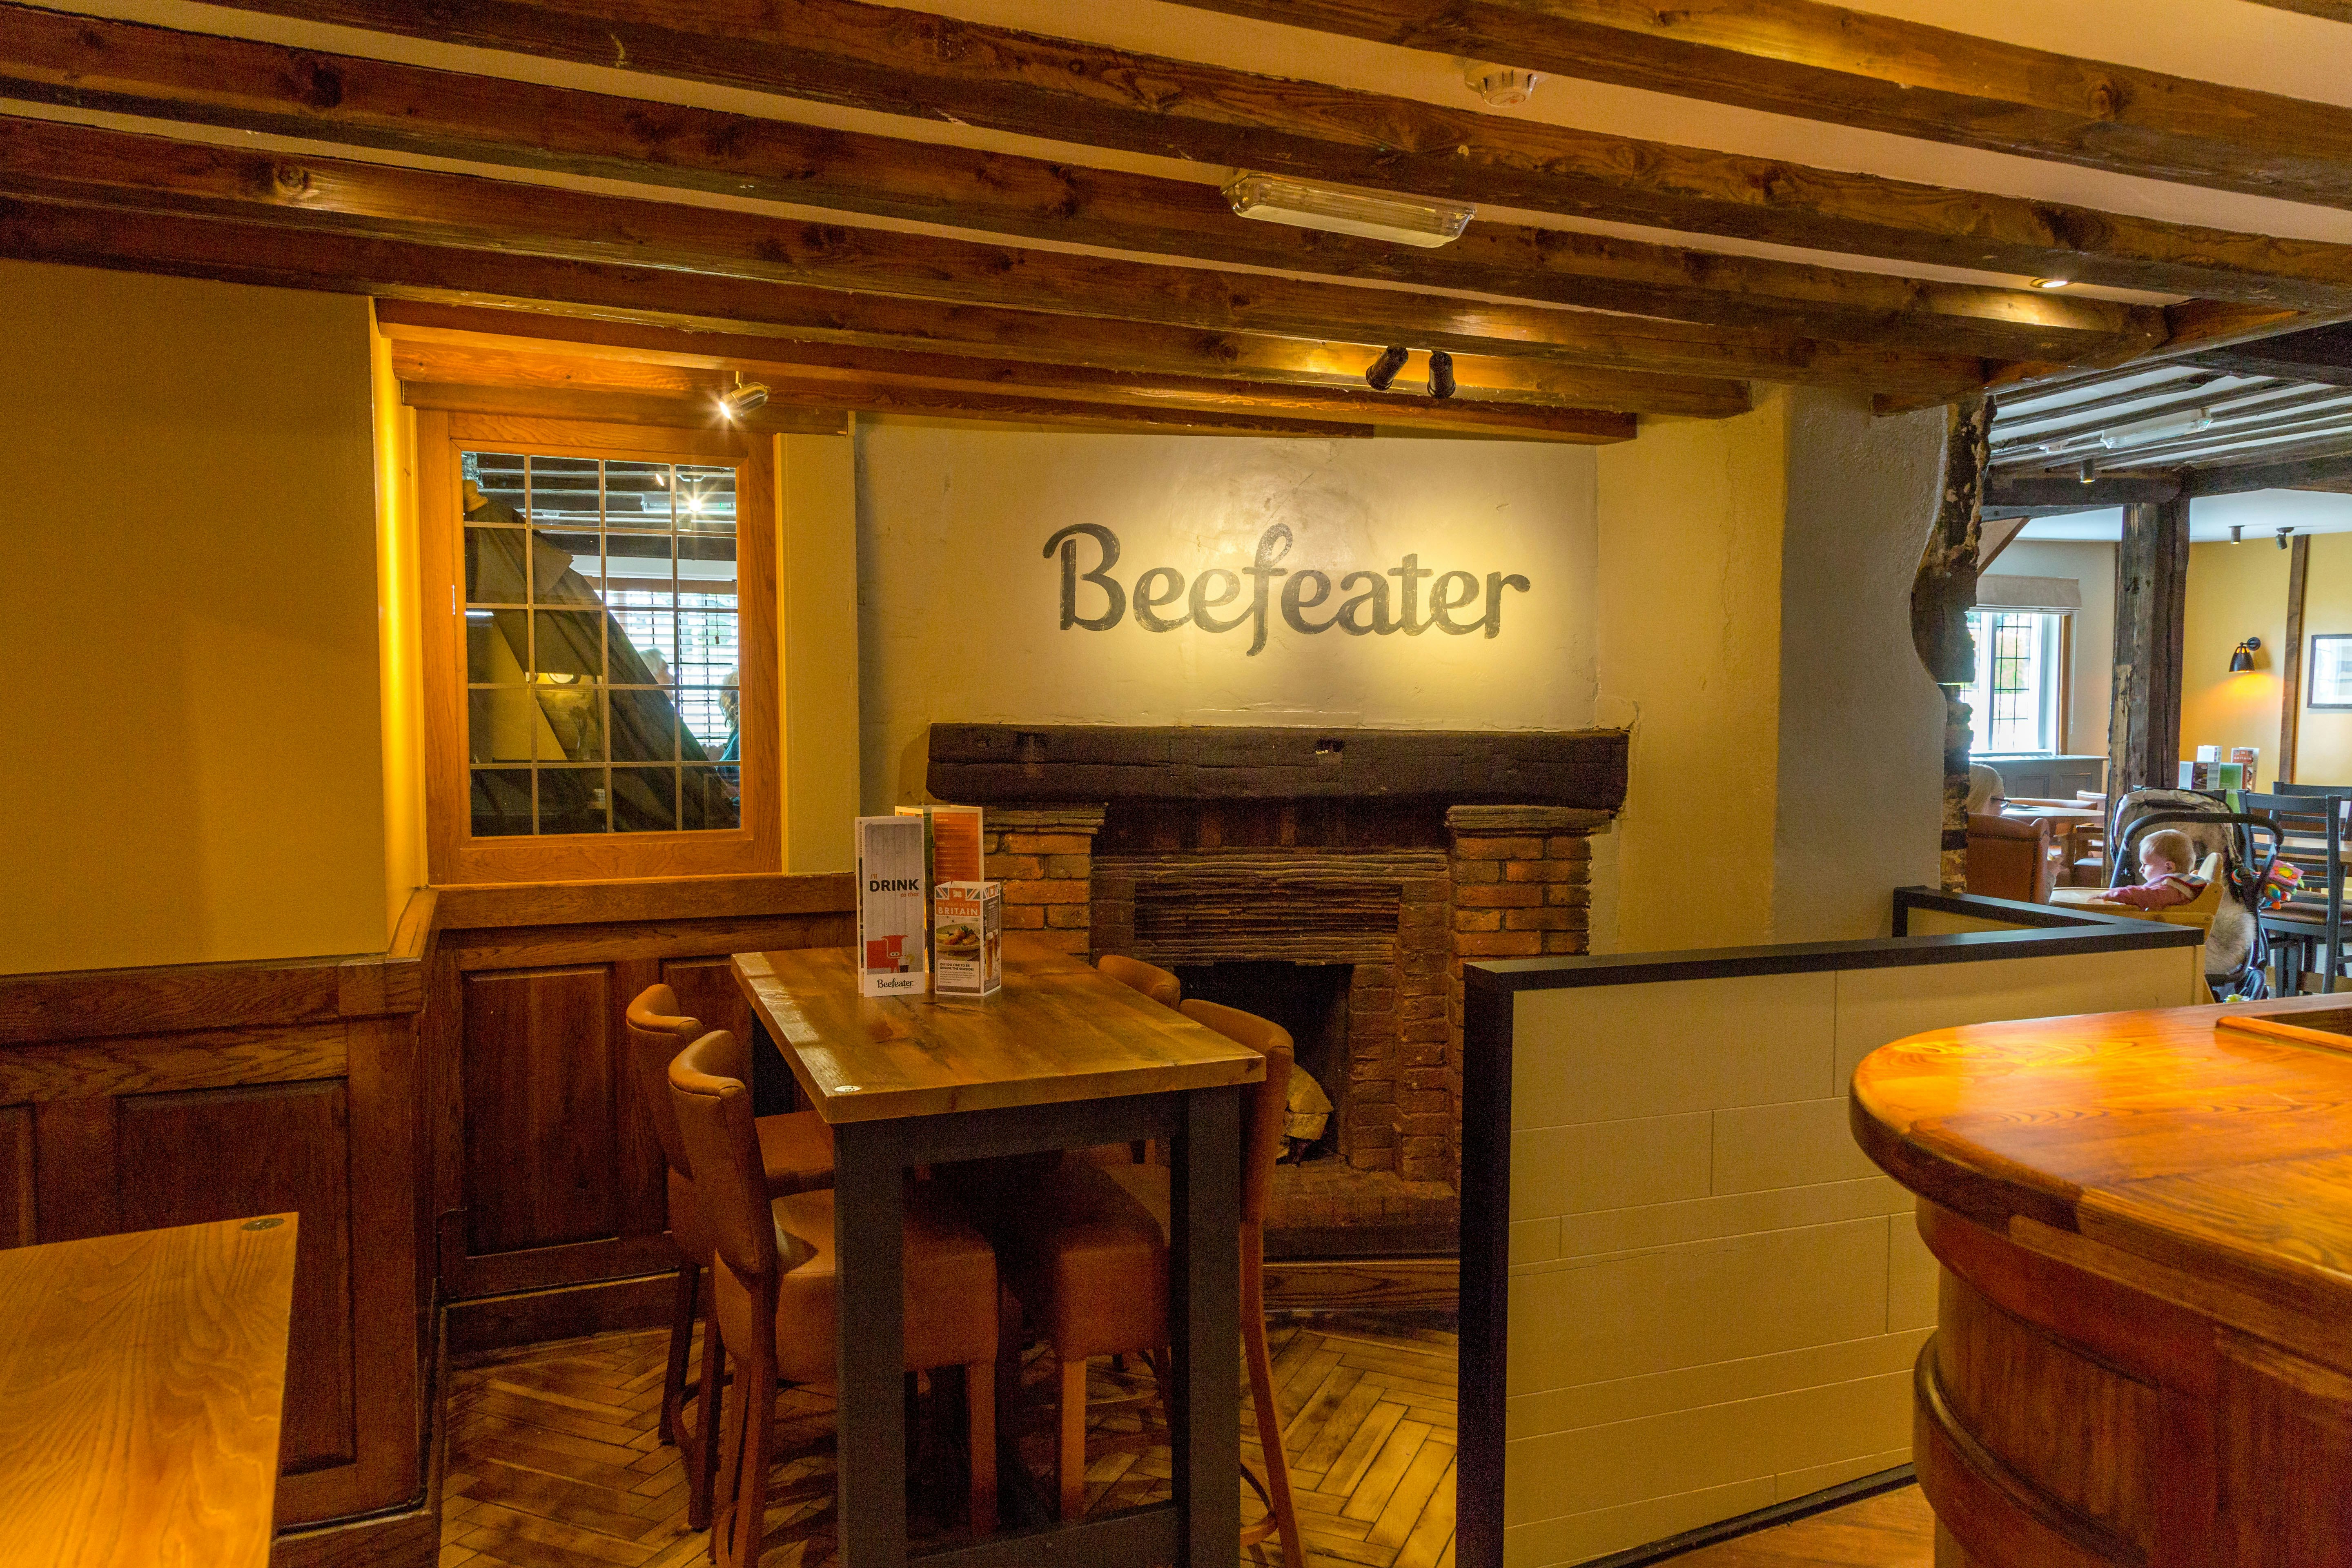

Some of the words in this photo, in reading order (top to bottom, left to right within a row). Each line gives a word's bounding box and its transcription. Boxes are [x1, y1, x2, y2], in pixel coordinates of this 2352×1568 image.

[1042, 523, 1531, 657] Beefeater
[869, 879, 919, 892] DRINK
[938, 907, 978, 915] BRITAIN
